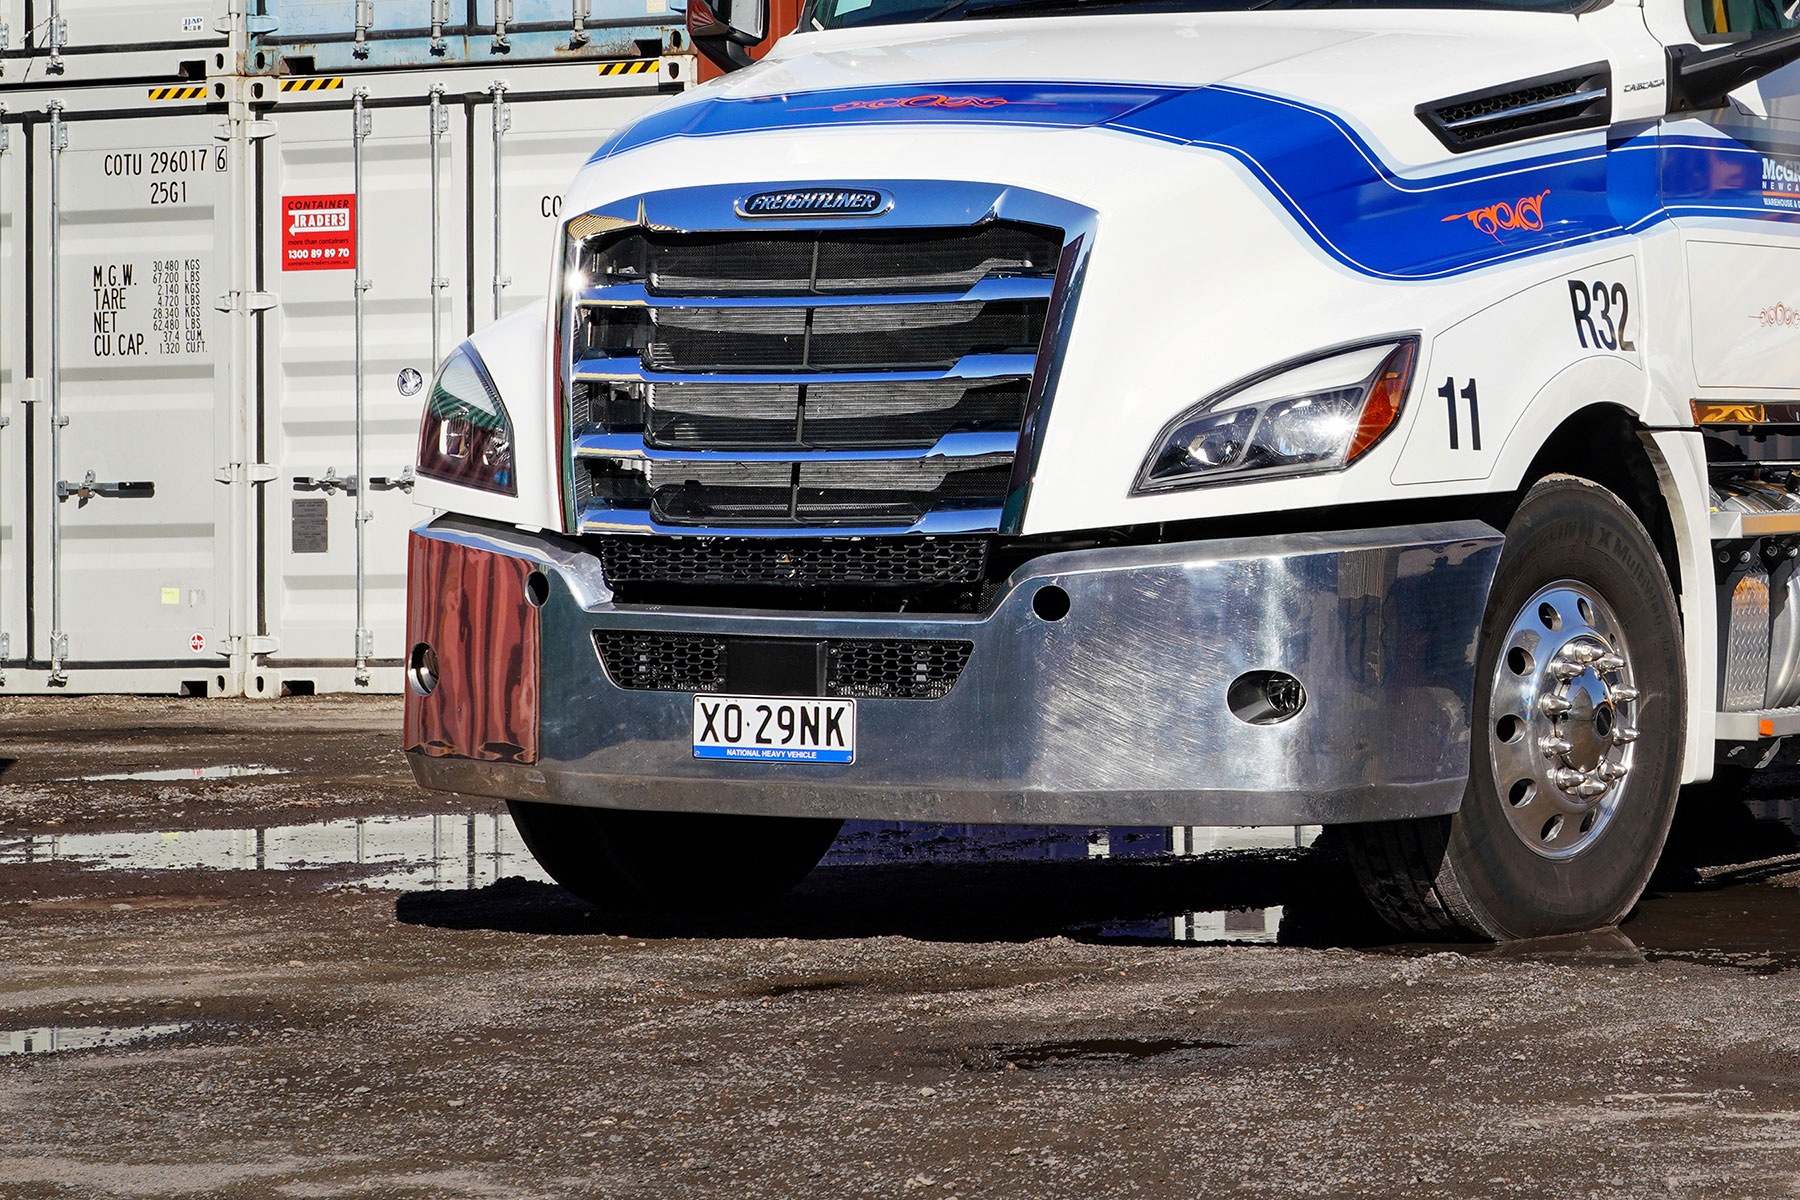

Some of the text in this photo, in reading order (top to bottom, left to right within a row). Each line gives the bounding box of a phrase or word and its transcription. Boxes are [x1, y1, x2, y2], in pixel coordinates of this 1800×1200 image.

[104, 148, 226, 176] COTU 296017 6
[150, 181, 187, 204] 25G1
[288, 199, 349, 210] CONTAINER
[749, 192, 876, 211] FREIGHTLINER
[1763, 197, 1794, 208] WAREHOUSE
[291, 210, 346, 228] TRADERS
[304, 237, 317, 245] than
[319, 237, 349, 245] containers
[288, 247, 350, 259] 1300 89 89 70
[152, 259, 200, 272] 30.480 KGS
[93, 263, 137, 288] M.G.W.
[152, 270, 200, 284] 67.200 LBS
[157, 282, 200, 296] 2.140 KGS
[94, 287, 127, 310] TARE
[157, 294, 200, 308] 4.720 LBS
[152, 306, 201, 320] 28.340 KGS
[1566, 279, 1637, 352] R32
[93, 311, 118, 334] NET
[152, 318, 201, 331] 62.480 LBS
[162, 331, 180, 343] 37.4
[159, 342, 180, 355] 1.320
[1437, 376, 1482, 451] 11
[755, 704, 846, 747] 29NK
[726, 748, 818, 760] NATIONAL HEAVY VEHICLE
